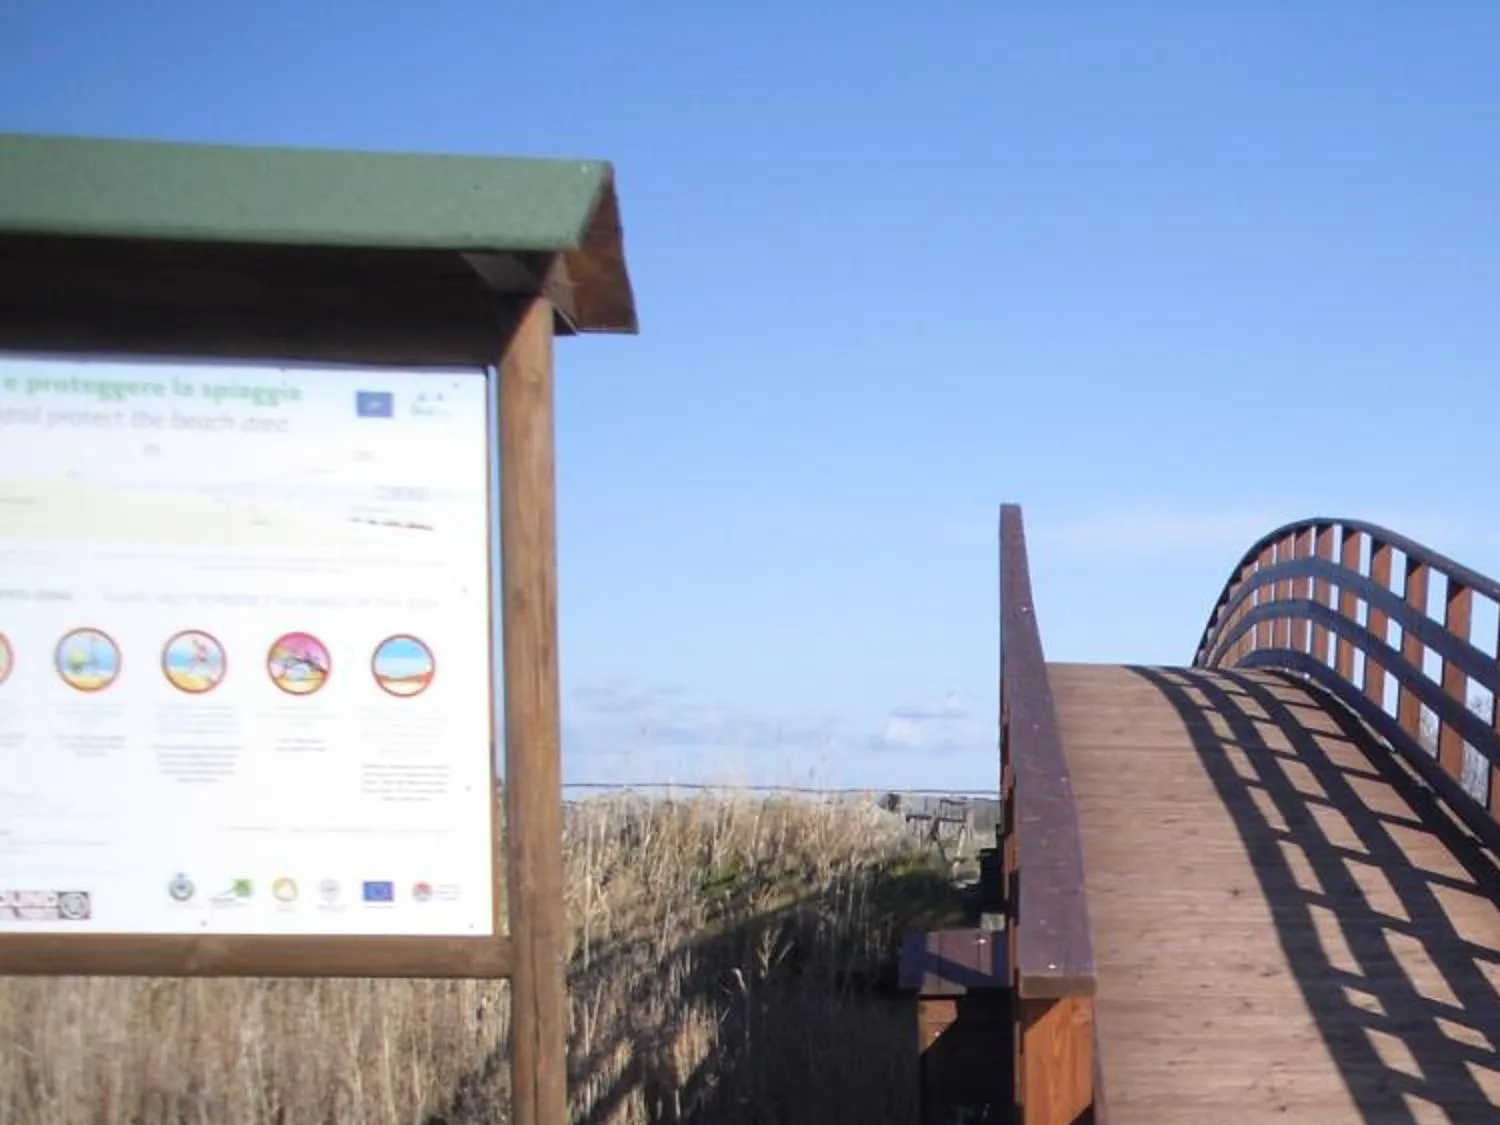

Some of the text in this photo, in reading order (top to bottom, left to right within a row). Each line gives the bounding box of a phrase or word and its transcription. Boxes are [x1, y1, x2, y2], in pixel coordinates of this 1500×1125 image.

[3, 376, 303, 407] e proteggere la spiaggia
[46, 409, 124, 428] protect
[130, 411, 164, 430] the
[170, 411, 234, 432] beach
